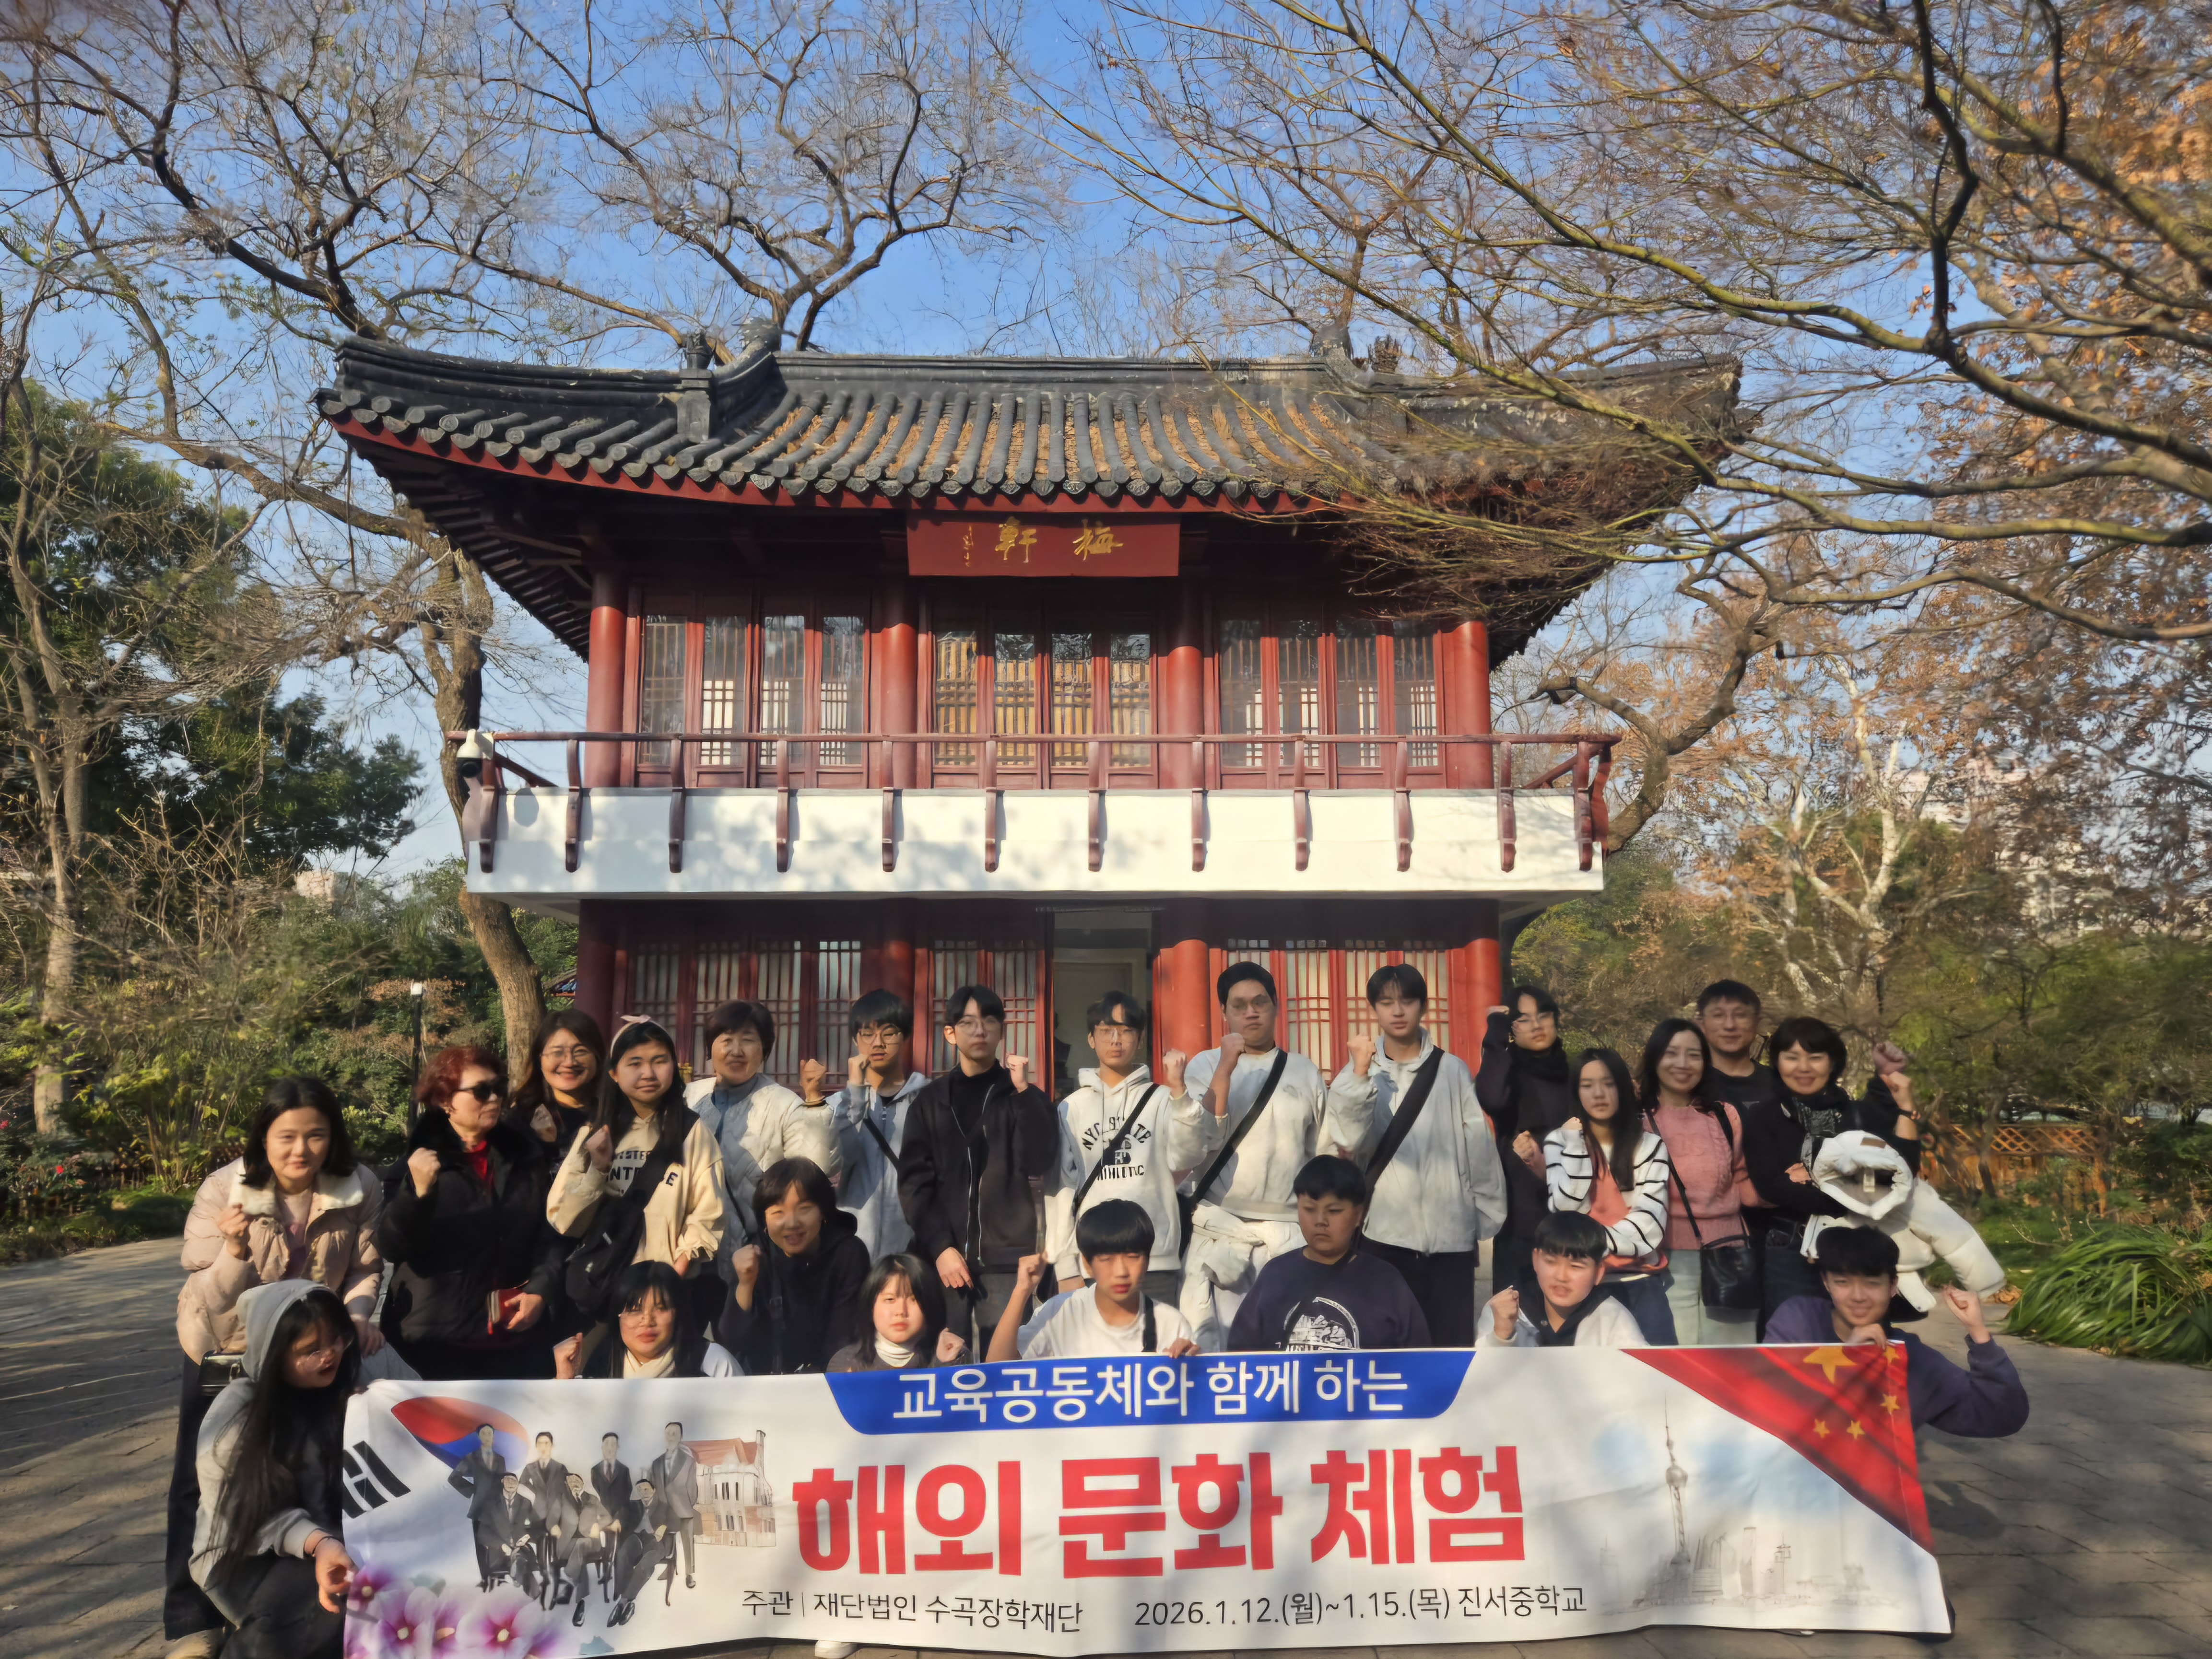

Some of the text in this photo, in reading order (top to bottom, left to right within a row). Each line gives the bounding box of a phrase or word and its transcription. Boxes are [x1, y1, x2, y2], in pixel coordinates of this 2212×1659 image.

[893, 1359, 1408, 1423] 교육공동체와 함께 하는
[793, 1446, 1525, 1579] 해외 문화 체험
[742, 1590, 1083, 1633] 주관 재단법인 수곡장학재단
[1458, 1585, 1587, 1617] 진서중학교
